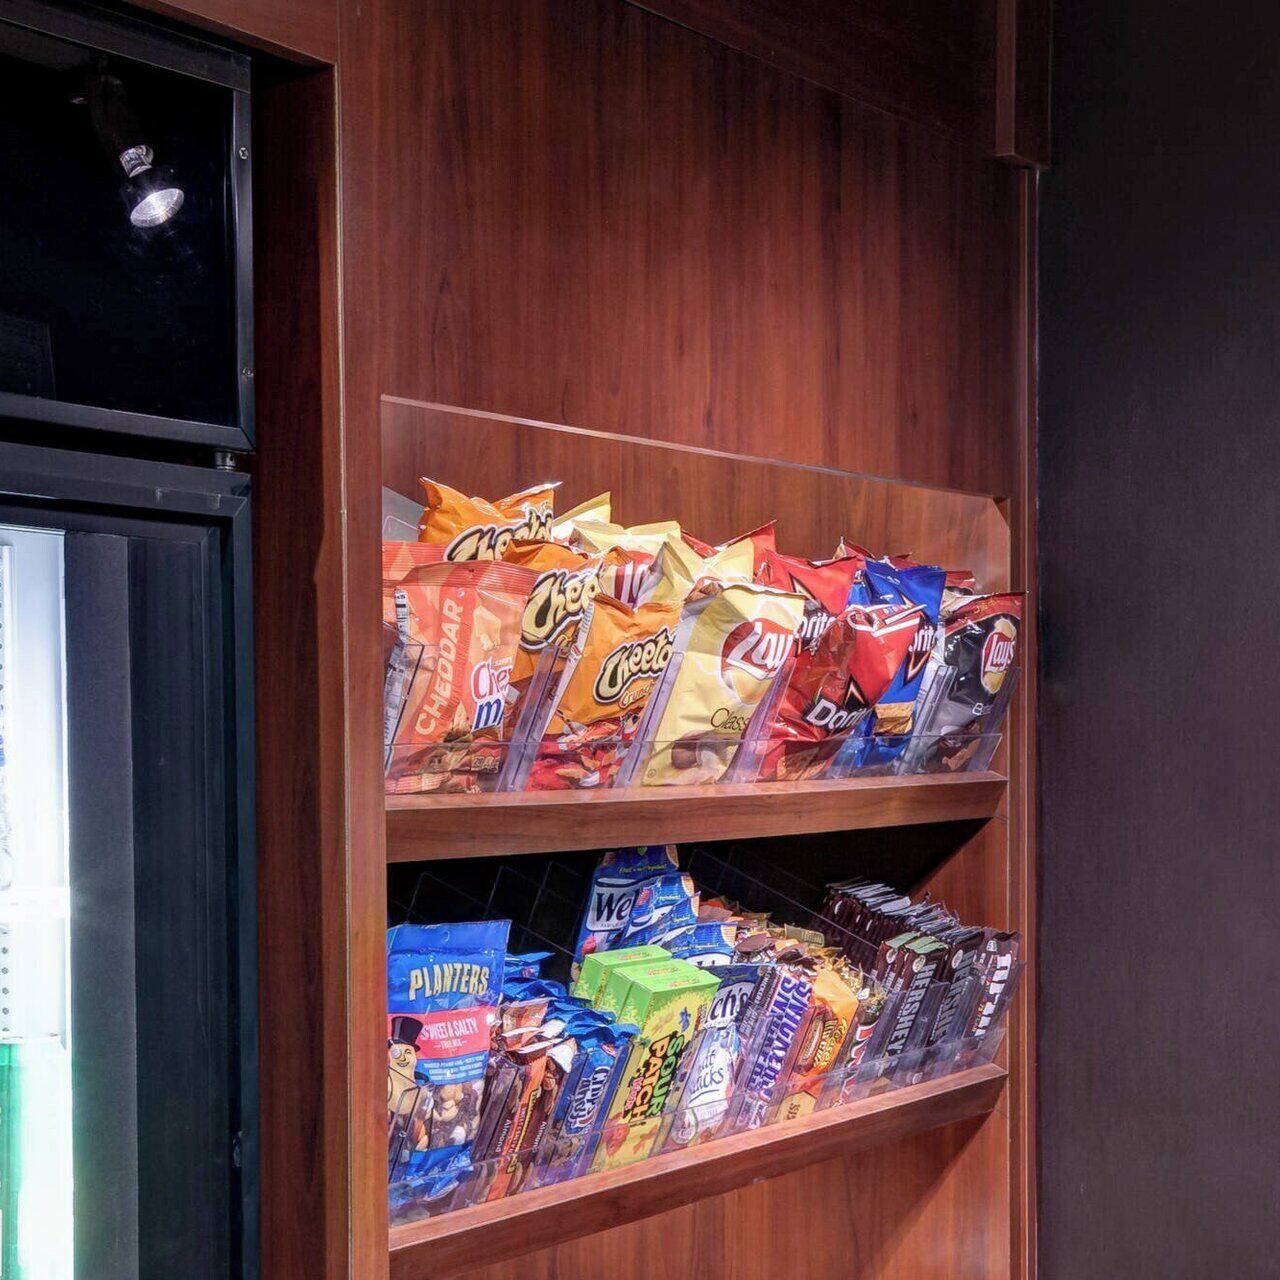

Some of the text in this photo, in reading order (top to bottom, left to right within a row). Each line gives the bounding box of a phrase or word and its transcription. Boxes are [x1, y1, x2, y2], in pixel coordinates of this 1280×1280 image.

[414, 598, 464, 736] CHEDDAR
[408, 962, 490, 1001] PLANTERS
[710, 985, 750, 1022] ch's
[887, 962, 938, 1054] HERSHEY'
[628, 1032, 671, 1122] PATCH
[647, 1033, 685, 1116] SOUR
